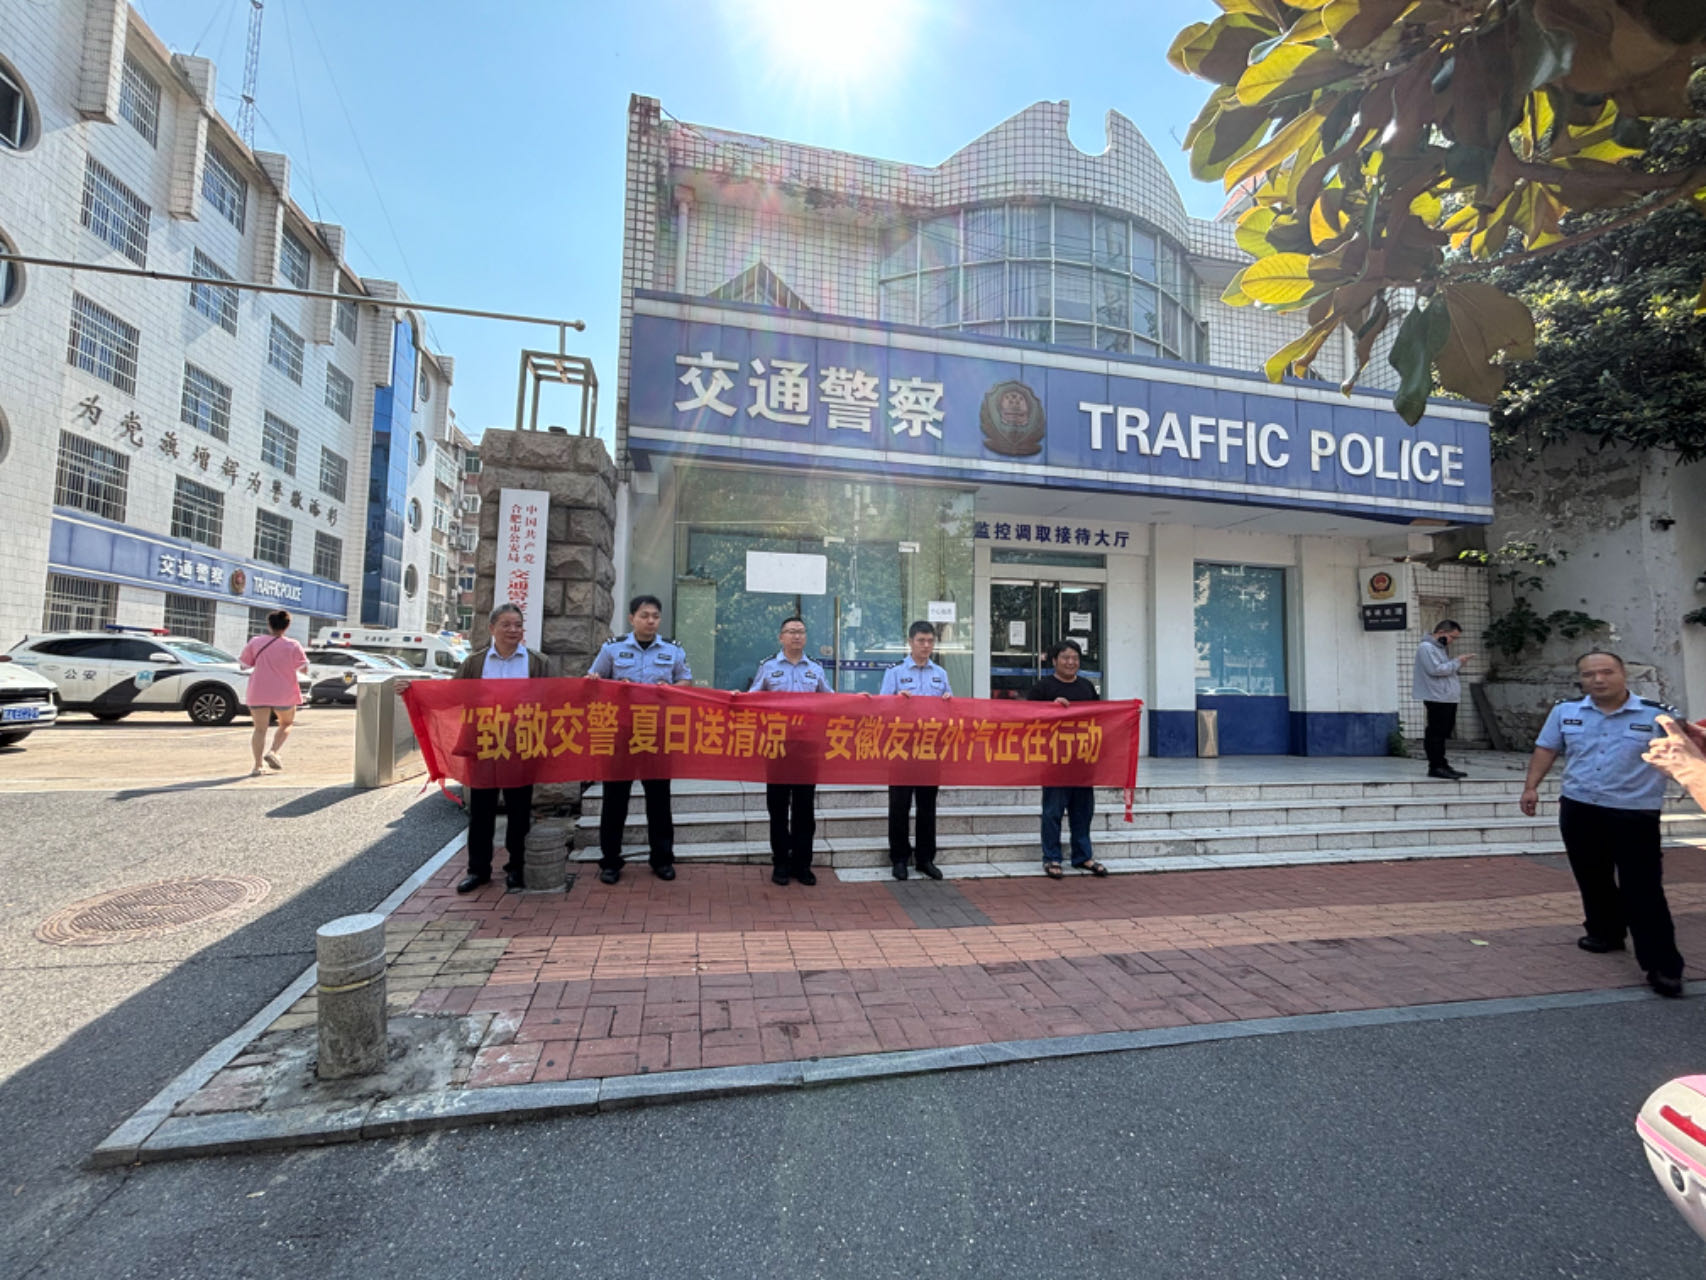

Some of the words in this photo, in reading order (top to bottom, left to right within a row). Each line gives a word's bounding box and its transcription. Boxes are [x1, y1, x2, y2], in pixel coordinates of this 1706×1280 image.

[675, 351, 946, 440] 交通警察
[1079, 401, 1290, 469] TRAFFIC
[1310, 429, 1465, 487] POLICE
[507, 503, 523, 564] 合肥市公安局
[523, 503, 538, 565] 中国共产党
[974, 521, 1130, 548] 监控调取接待大厅
[159, 554, 224, 585] 交通警察
[64, 668, 97, 680] 公安
[824, 715, 1103, 765] 安徽友谊外汽正在行动
